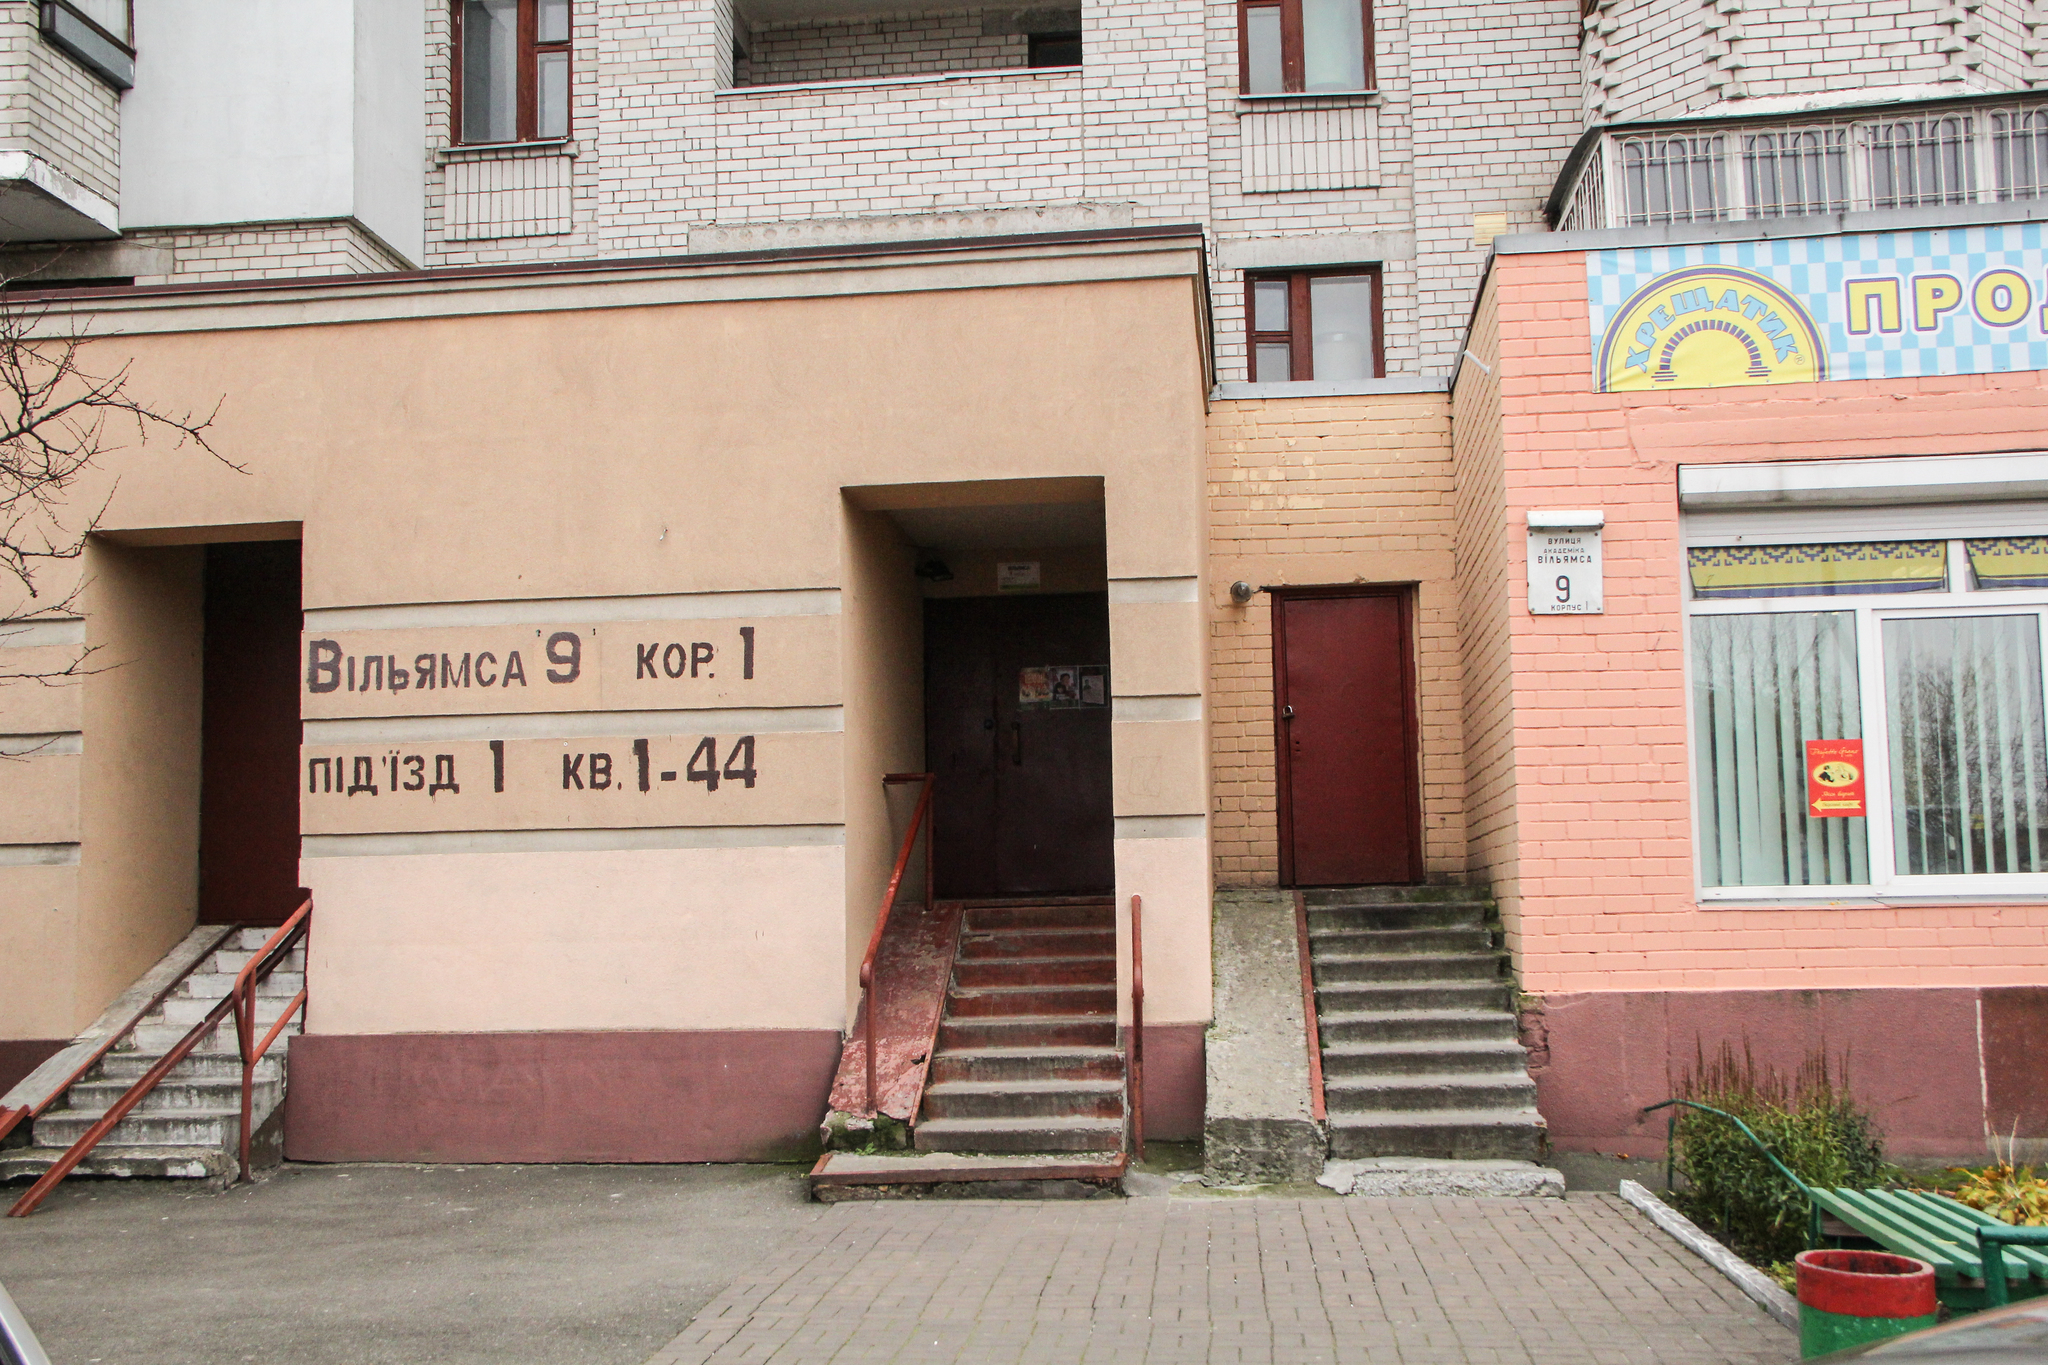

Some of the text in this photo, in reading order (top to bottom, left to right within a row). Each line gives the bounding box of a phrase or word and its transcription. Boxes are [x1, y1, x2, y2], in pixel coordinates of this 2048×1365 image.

[1845, 267, 2048, 335] ПРО
[1623, 285, 1800, 373] ХРЕЩАТИК
[1543, 546, 1586, 554] АКАДЕМІКА
[1547, 537, 1582, 545] ВУЛИЦЯ
[1537, 554, 1593, 564] ВІЛЬЯМСА
[1555, 574, 1571, 604] 9
[1550, 604, 1582, 612] КОРПУС
[545, 631, 583, 685] 9
[636, 641, 716, 680] КОР.
[739, 626, 755, 681] 1
[488, 739, 505, 794] 1
